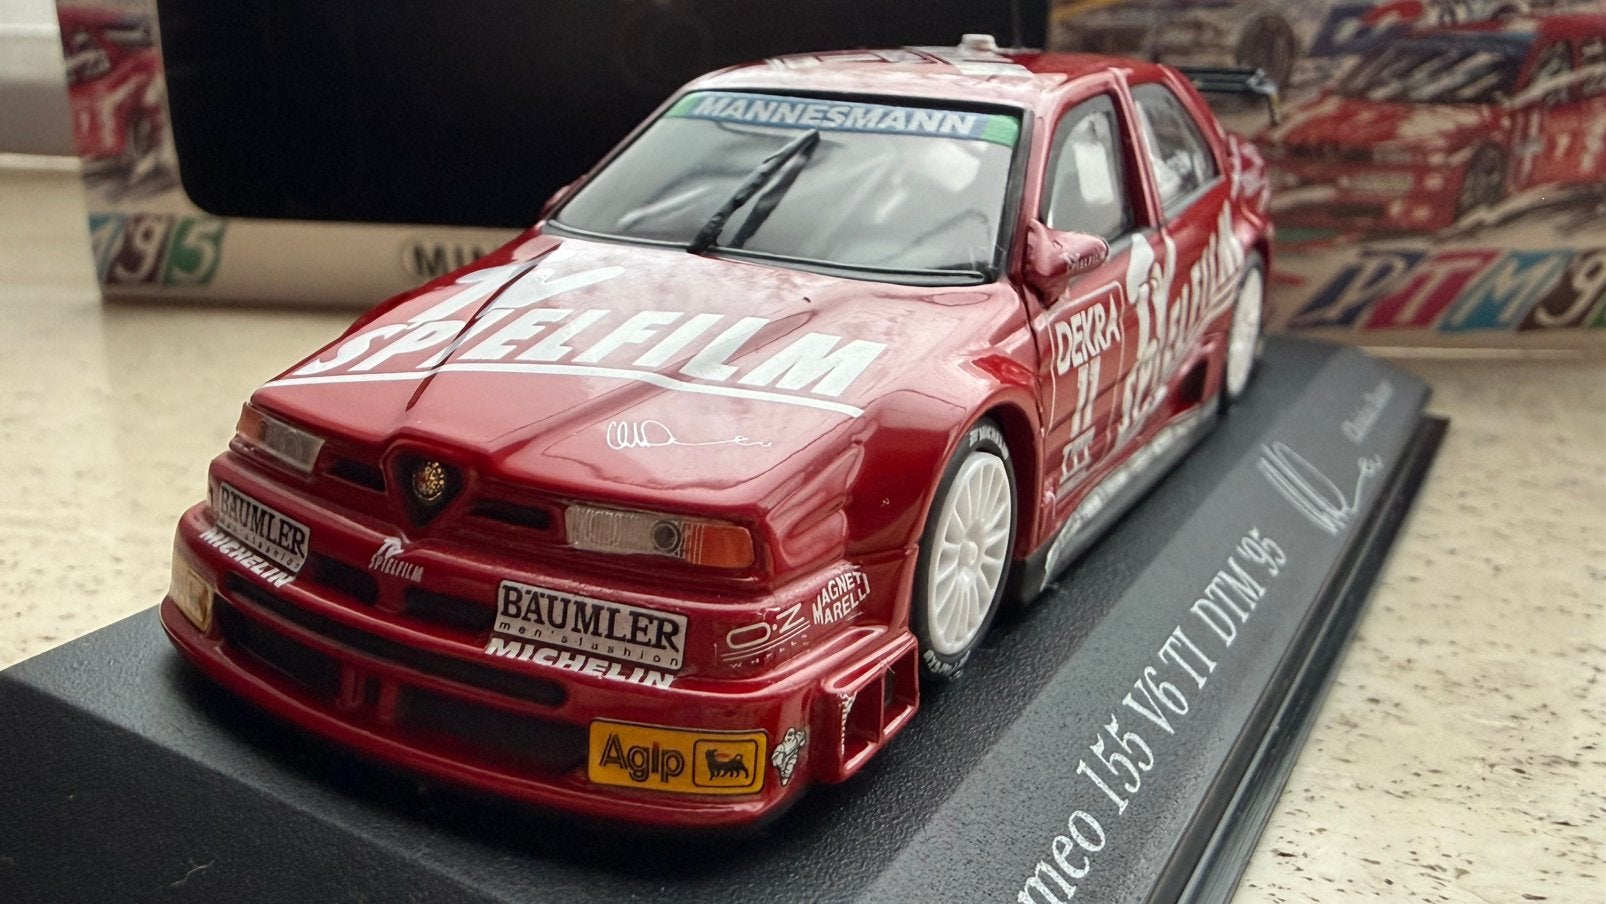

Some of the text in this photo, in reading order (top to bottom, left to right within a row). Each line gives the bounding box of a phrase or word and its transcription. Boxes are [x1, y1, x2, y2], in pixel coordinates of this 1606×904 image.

[695, 94, 977, 136] MANNESMANN
[292, 307, 889, 397] SPIELFILM
[1055, 293, 1121, 376] DEKRA
[199, 524, 297, 588] MICHELIN
[500, 584, 681, 653] BÄUMLER
[484, 637, 676, 690] MICHELIN
[1076, 713, 1154, 815] 155
[1121, 666, 1190, 735] V6
[1157, 624, 1218, 690] TI
[1190, 555, 1267, 648] DTM
[600, 733, 685, 783] Agip
